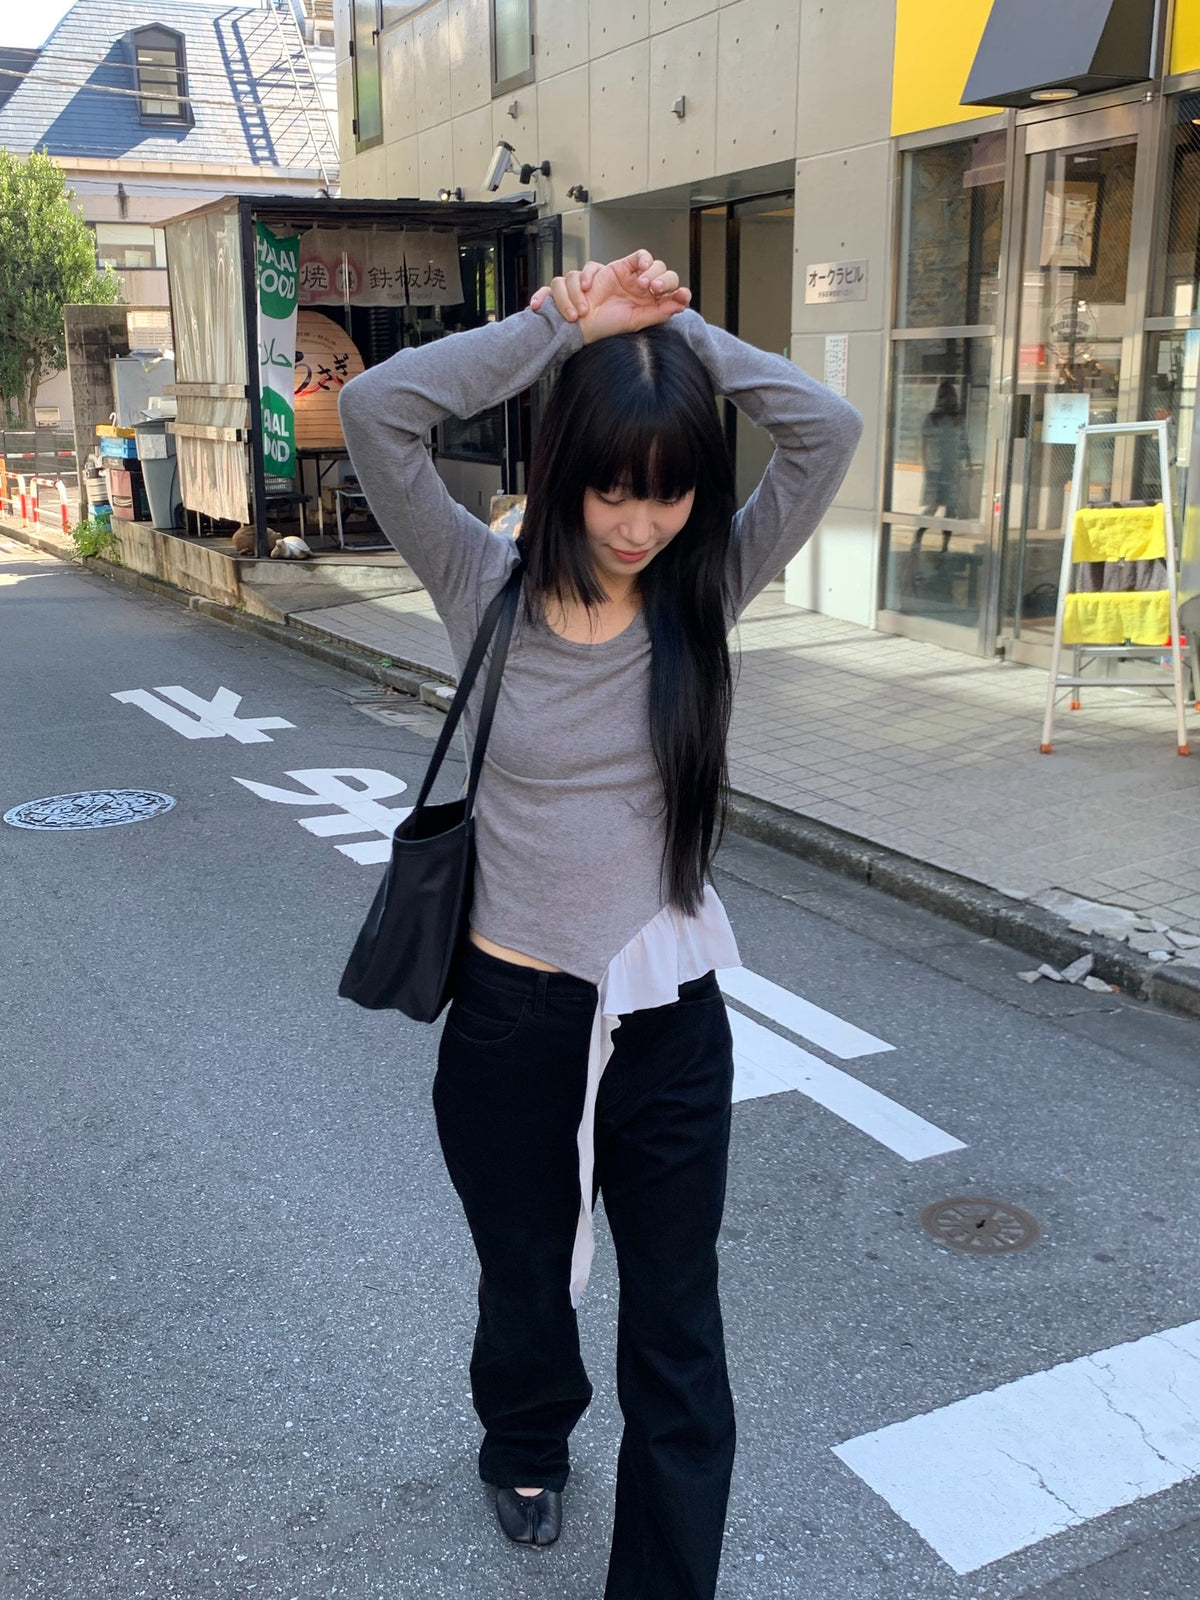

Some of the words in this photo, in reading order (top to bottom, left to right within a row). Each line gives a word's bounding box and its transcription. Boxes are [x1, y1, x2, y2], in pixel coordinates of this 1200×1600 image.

[368, 265, 447, 290] 鉄板焼
[808, 266, 864, 288] オークラビル
